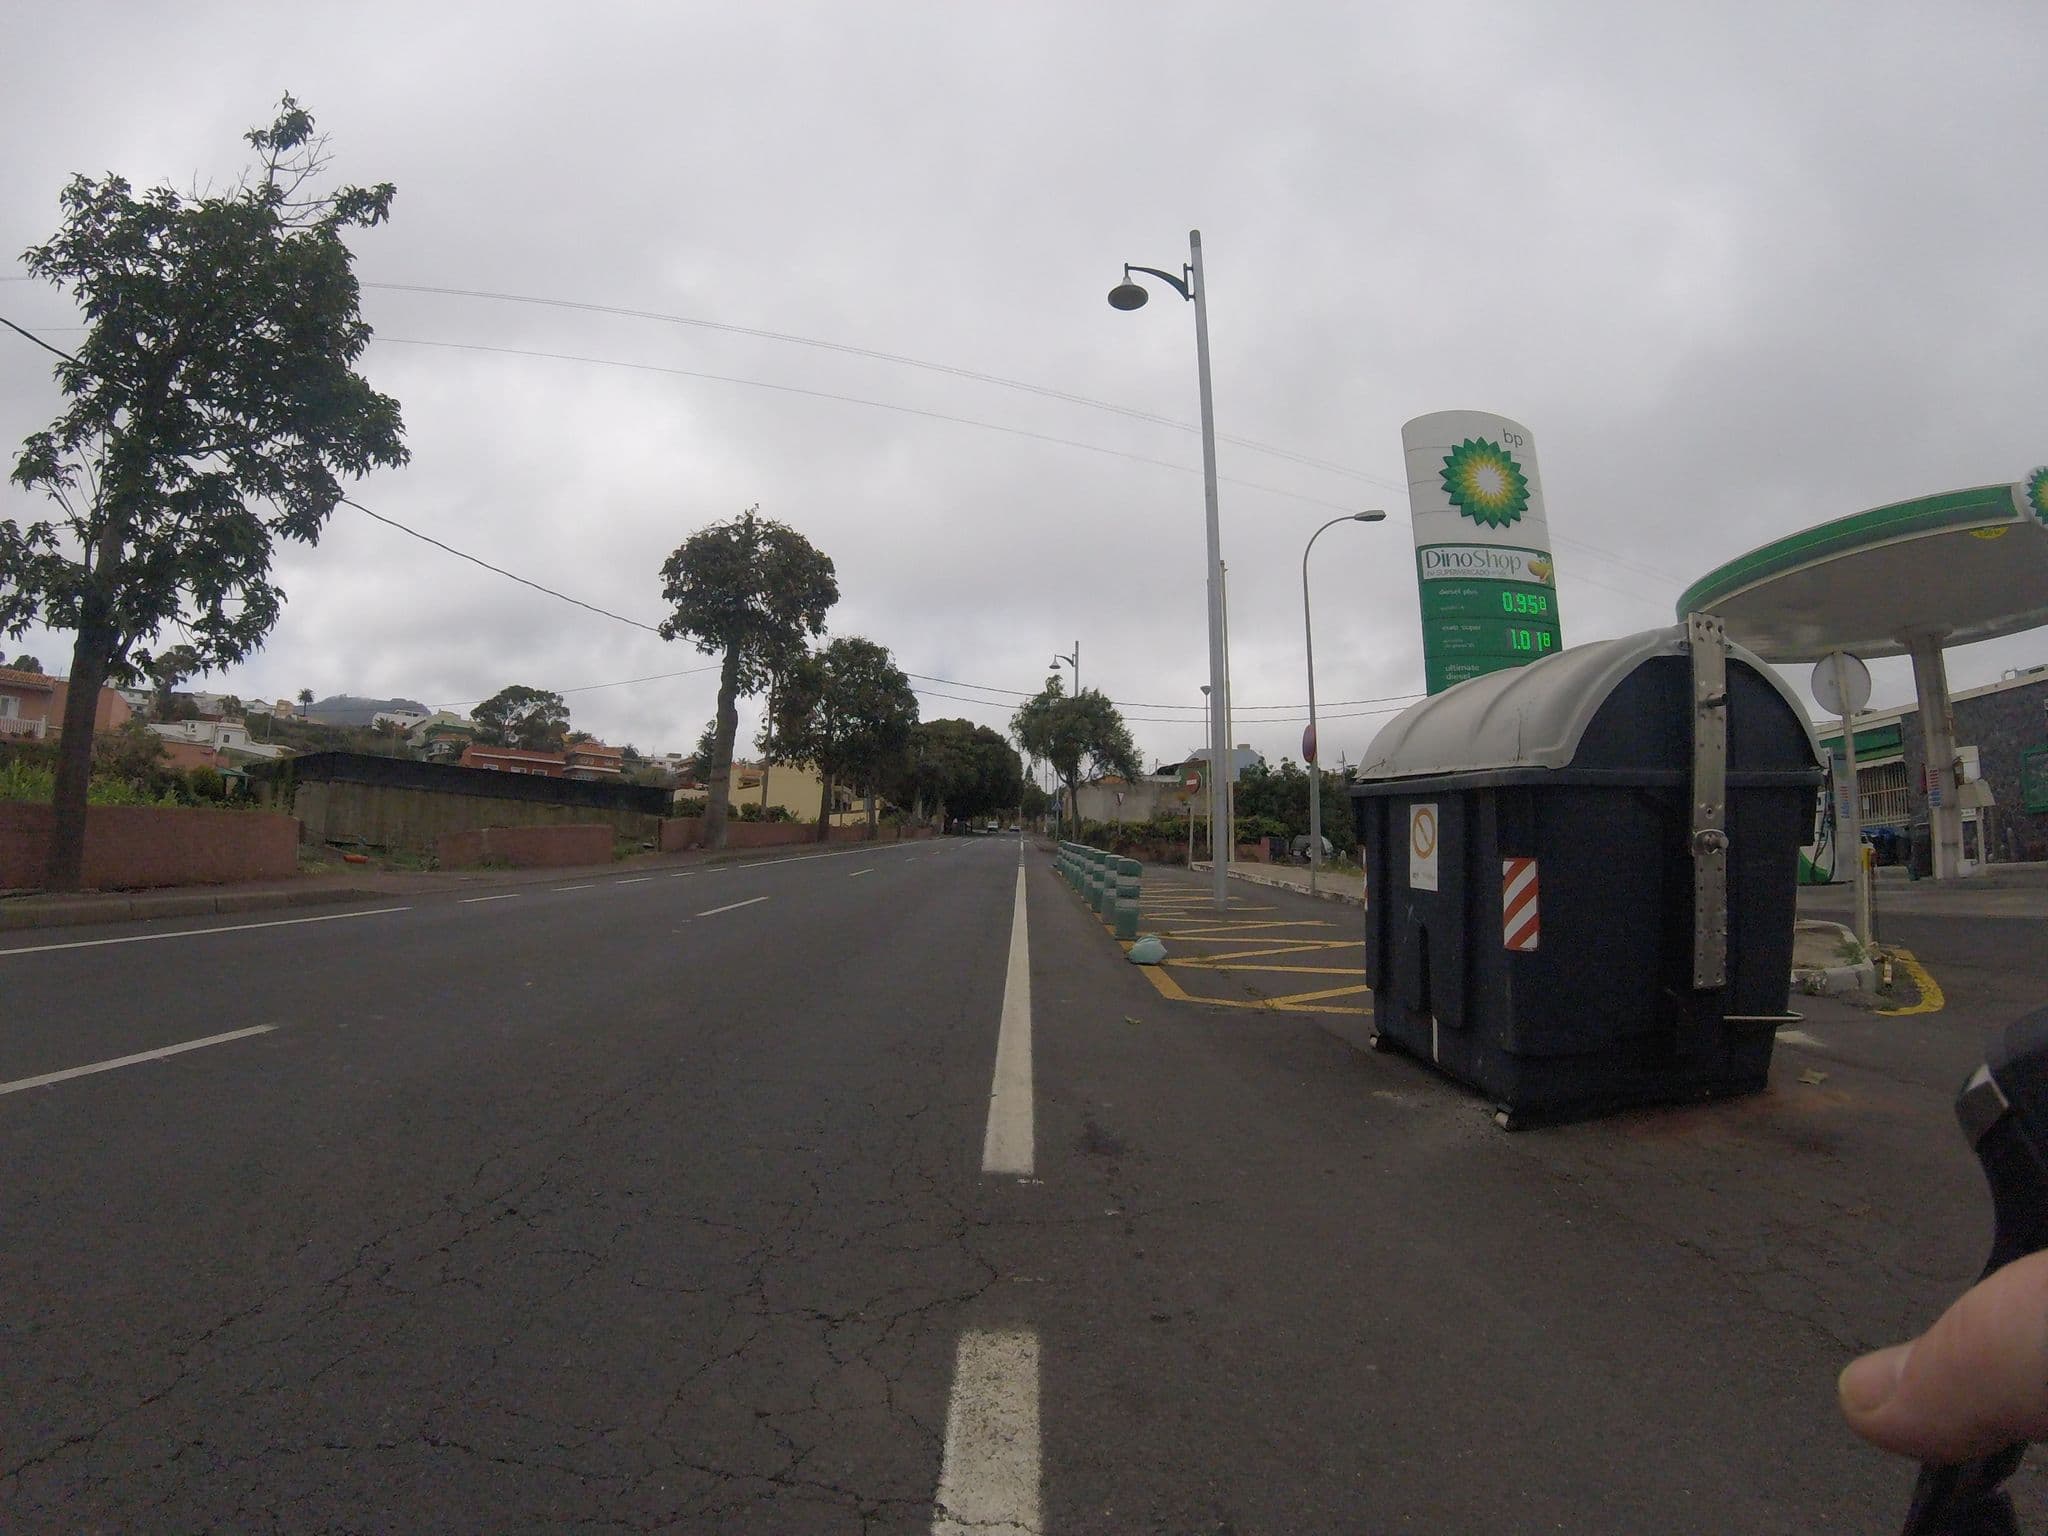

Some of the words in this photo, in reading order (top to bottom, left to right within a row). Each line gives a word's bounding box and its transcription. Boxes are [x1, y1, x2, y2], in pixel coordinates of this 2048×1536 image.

[1503, 427, 1523, 448] bp
[1426, 549, 1521, 574] DinoShop
[1445, 664, 1480, 672] ultimate
